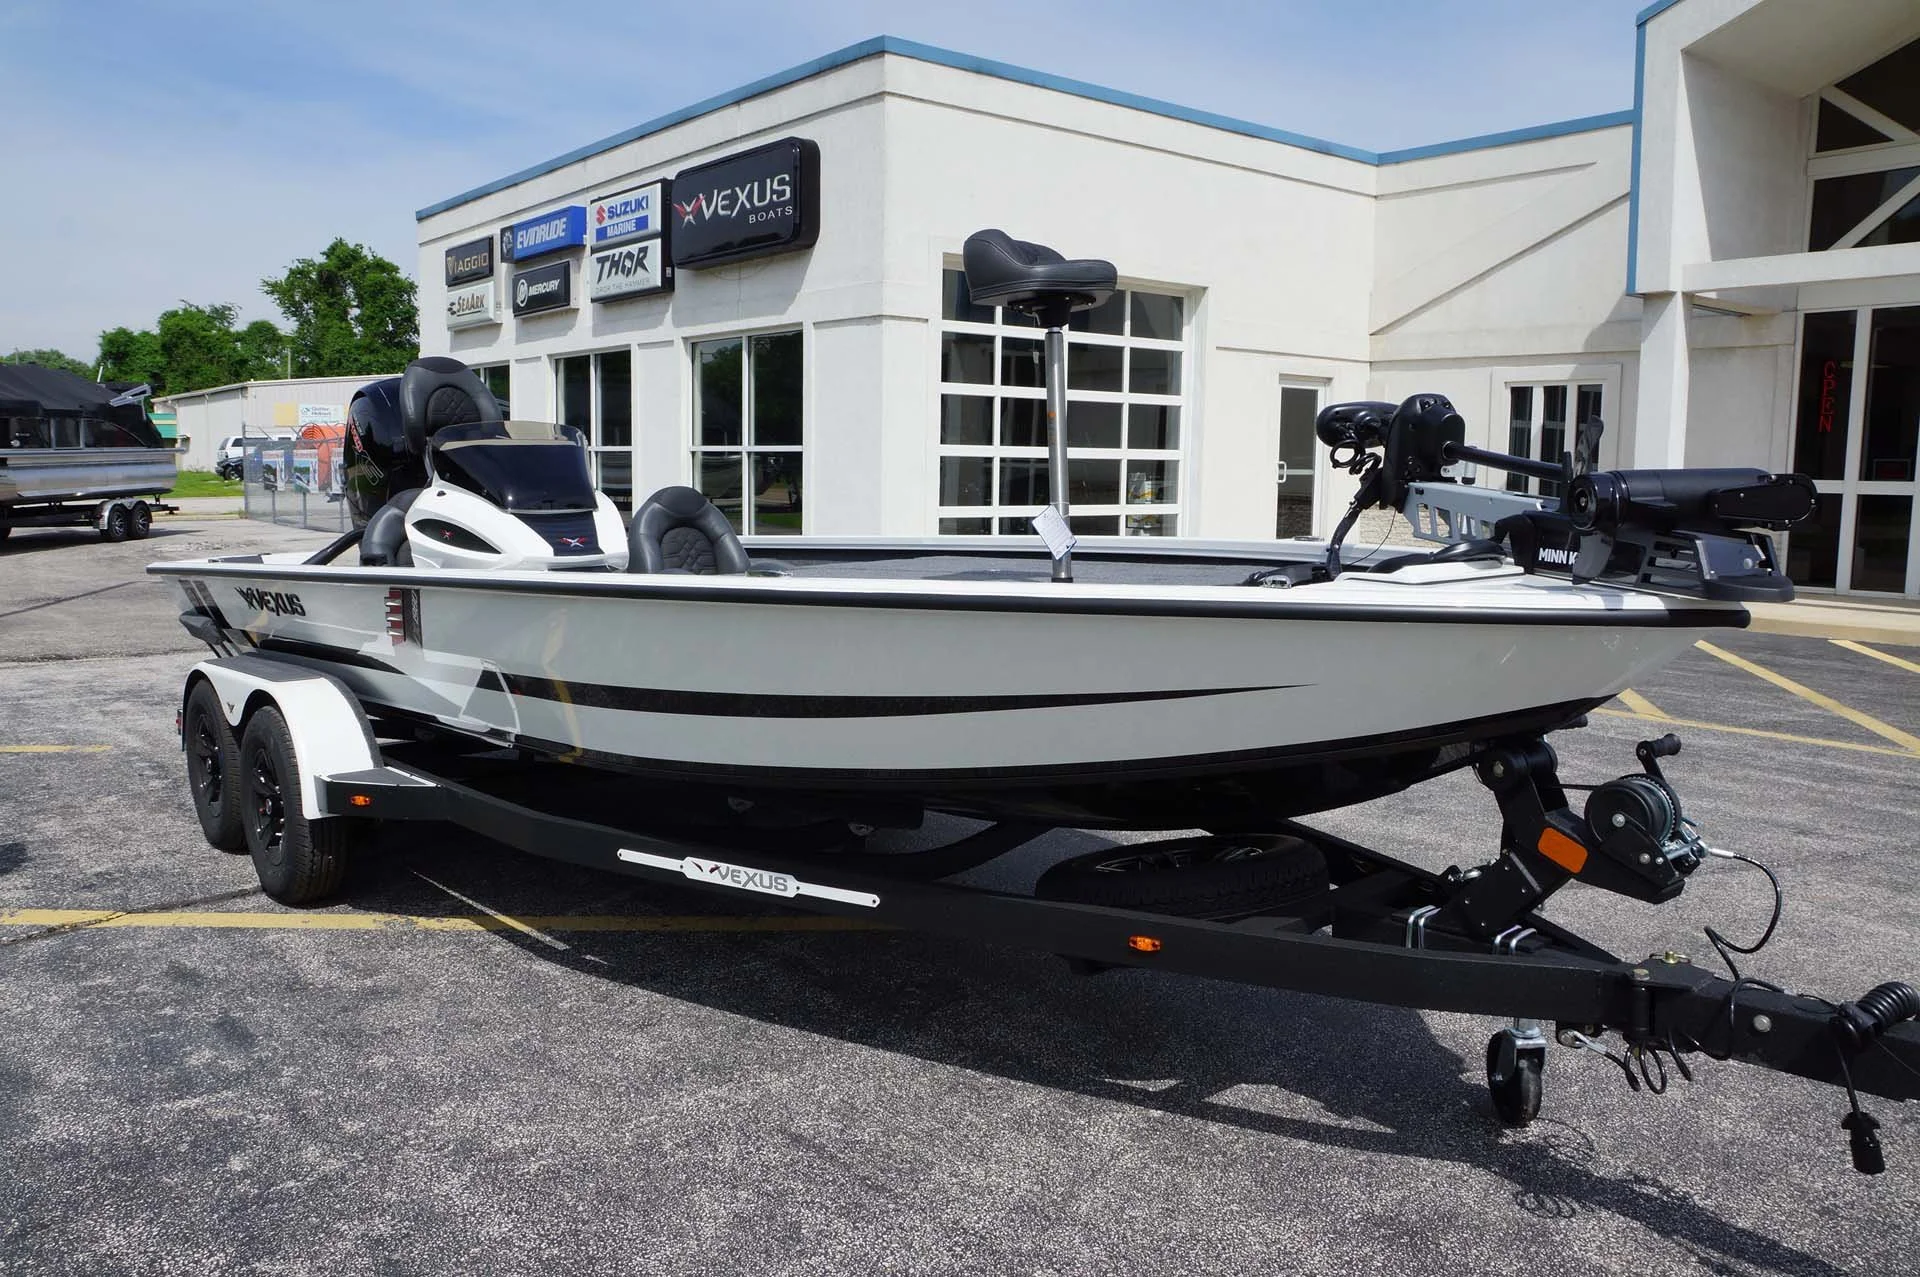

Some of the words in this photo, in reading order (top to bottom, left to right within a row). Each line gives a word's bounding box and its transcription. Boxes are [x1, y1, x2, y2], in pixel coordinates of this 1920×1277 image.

[607, 195, 649, 220] SUZUKI
[700, 174, 791, 221] VEXUS
[748, 205, 793, 224] BOATS
[516, 217, 567, 249] EVINRUDE
[607, 218, 637, 237] MARINE
[446, 252, 489, 275] VIAGGIO
[596, 246, 650, 284] THOR
[528, 279, 561, 297] MERCURY
[1538, 547, 1568, 565] MINN
[250, 588, 306, 617] VEXUS
[717, 865, 789, 892] VEXUS
